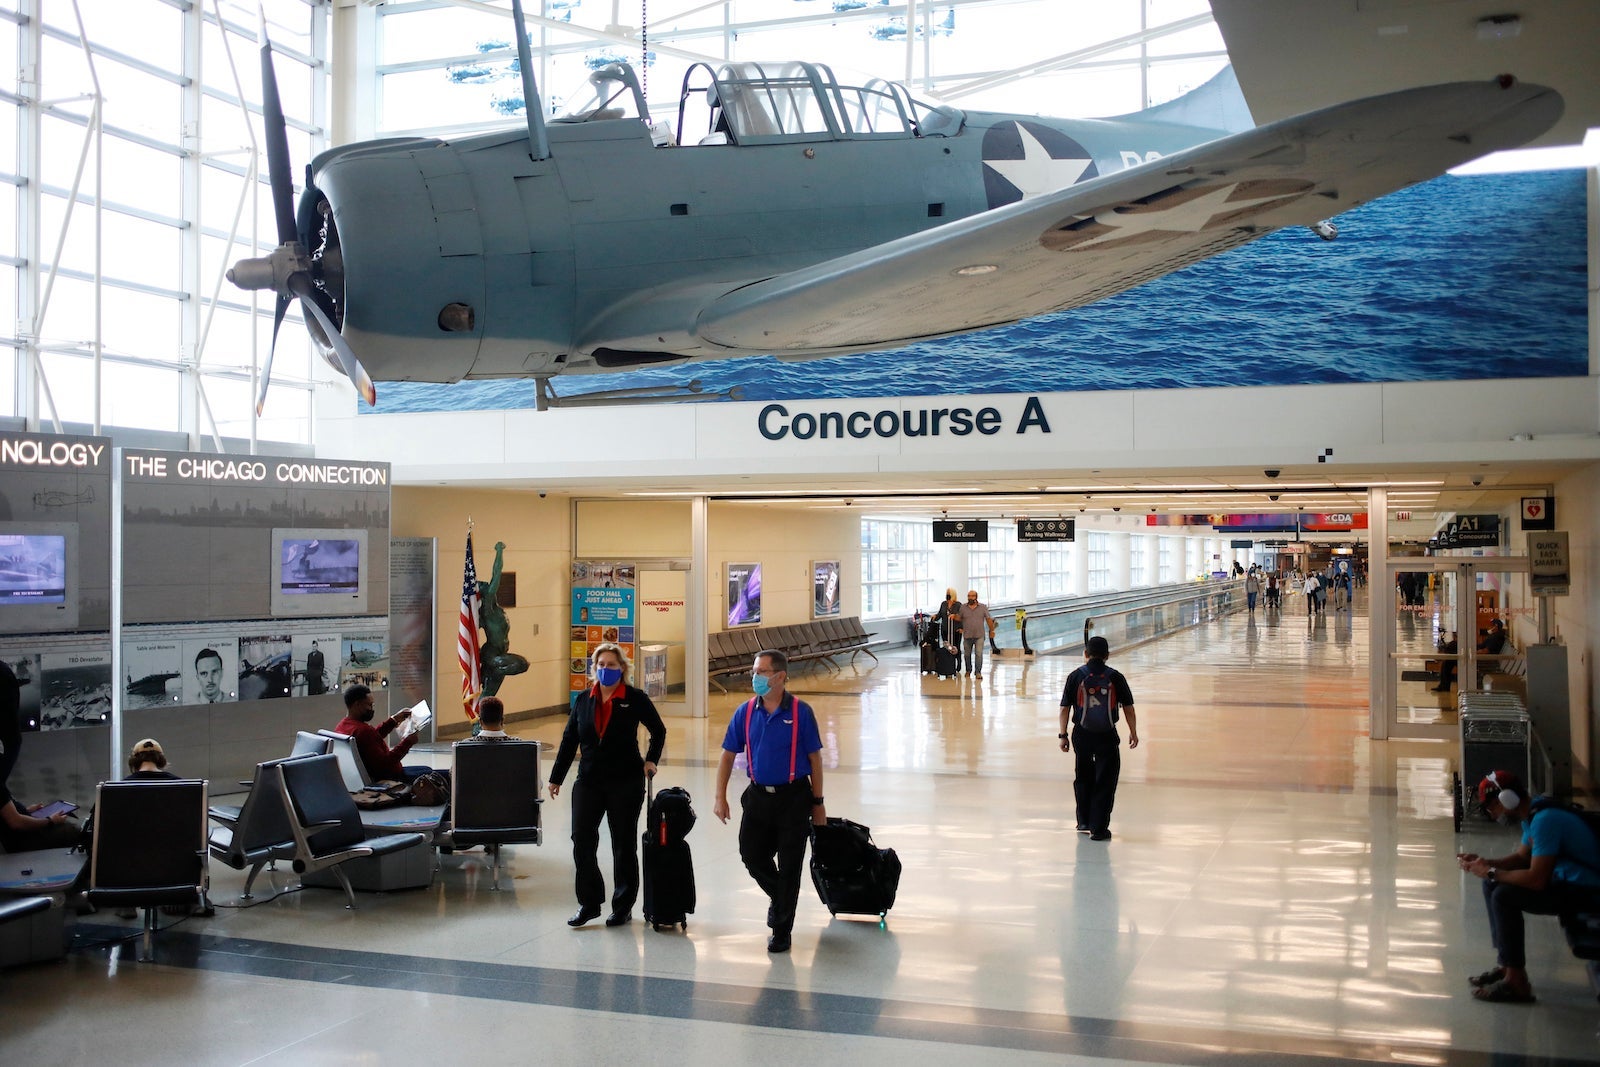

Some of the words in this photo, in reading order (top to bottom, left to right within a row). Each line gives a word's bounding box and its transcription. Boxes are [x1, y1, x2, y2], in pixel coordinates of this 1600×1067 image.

[758, 403, 1002, 440] Concourse
[1016, 396, 1051, 434] A
[1, 440, 105, 467] NOLOGY
[126, 456, 167, 477] THE
[177, 459, 266, 481] CHICAGO
[276, 463, 387, 485] CONNECTION
[1331, 513, 1352, 522] CDA
[1459, 516, 1479, 530] A1
